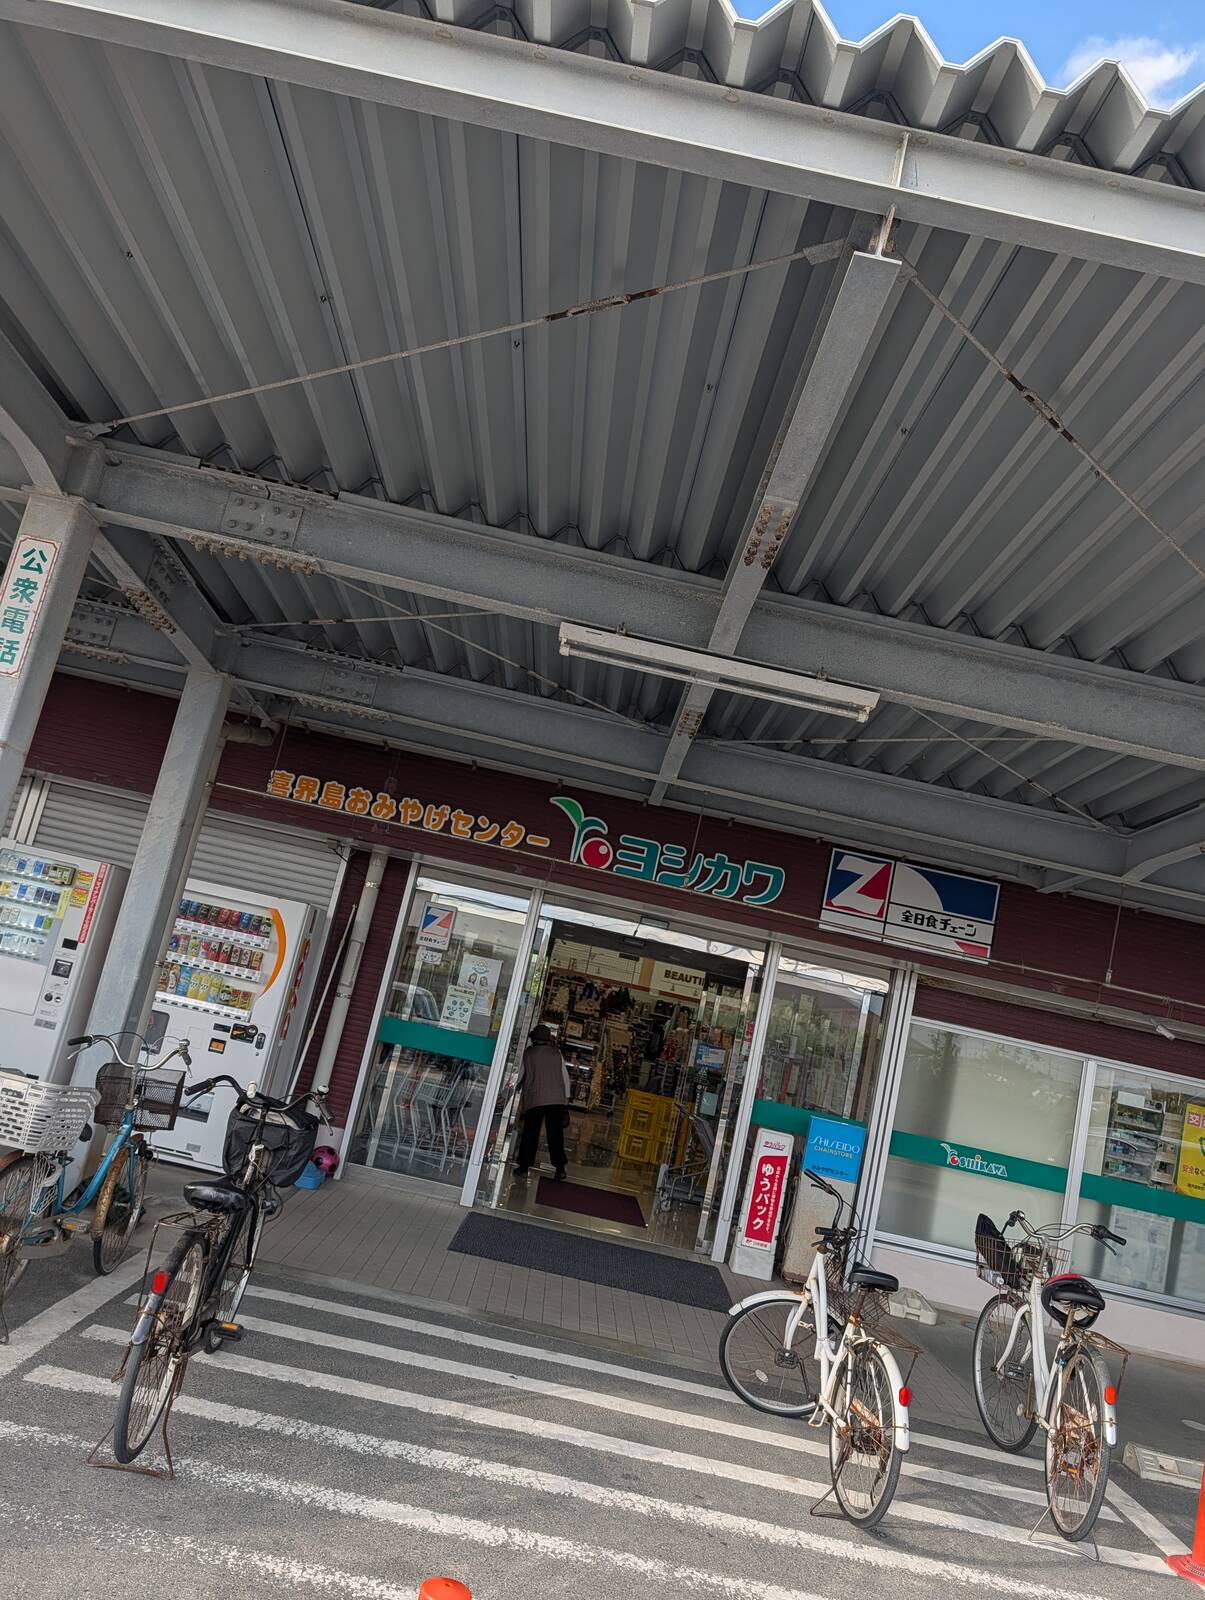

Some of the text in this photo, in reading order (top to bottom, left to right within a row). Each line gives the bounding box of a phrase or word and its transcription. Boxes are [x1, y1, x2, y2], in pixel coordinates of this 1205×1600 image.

[0, 547, 48, 665] 公衆電話
[267, 770, 550, 848] 喜界島おみやげセンター
[613, 834, 785, 904] ヨシカワ
[901, 910, 977, 937] 全日食チェーン
[810, 1136, 860, 1154] SHISEIDO
[752, 1163, 775, 1231] ゆうパック
